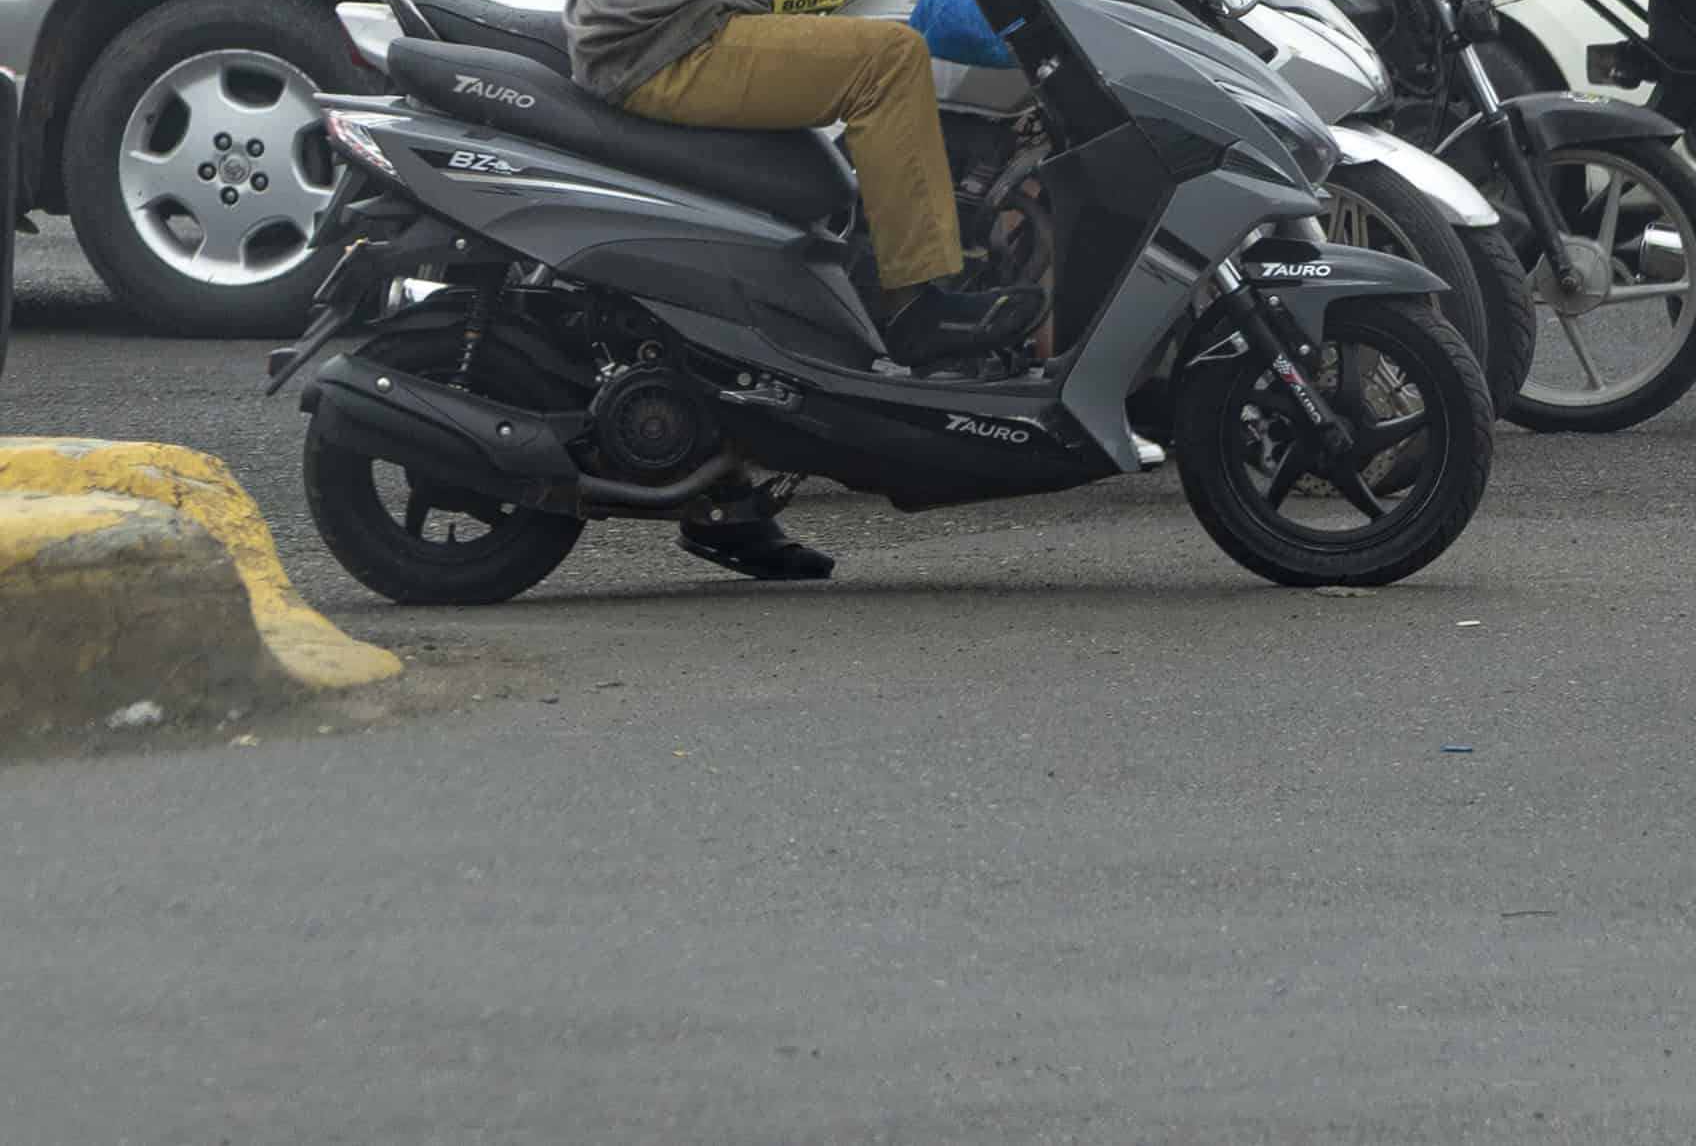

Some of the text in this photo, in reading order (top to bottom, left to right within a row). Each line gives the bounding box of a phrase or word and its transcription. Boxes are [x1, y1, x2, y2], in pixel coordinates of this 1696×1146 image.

[453, 73, 536, 108] TAURO
[1262, 262, 1332, 278] TAURO
[945, 413, 1030, 443] TAURO
